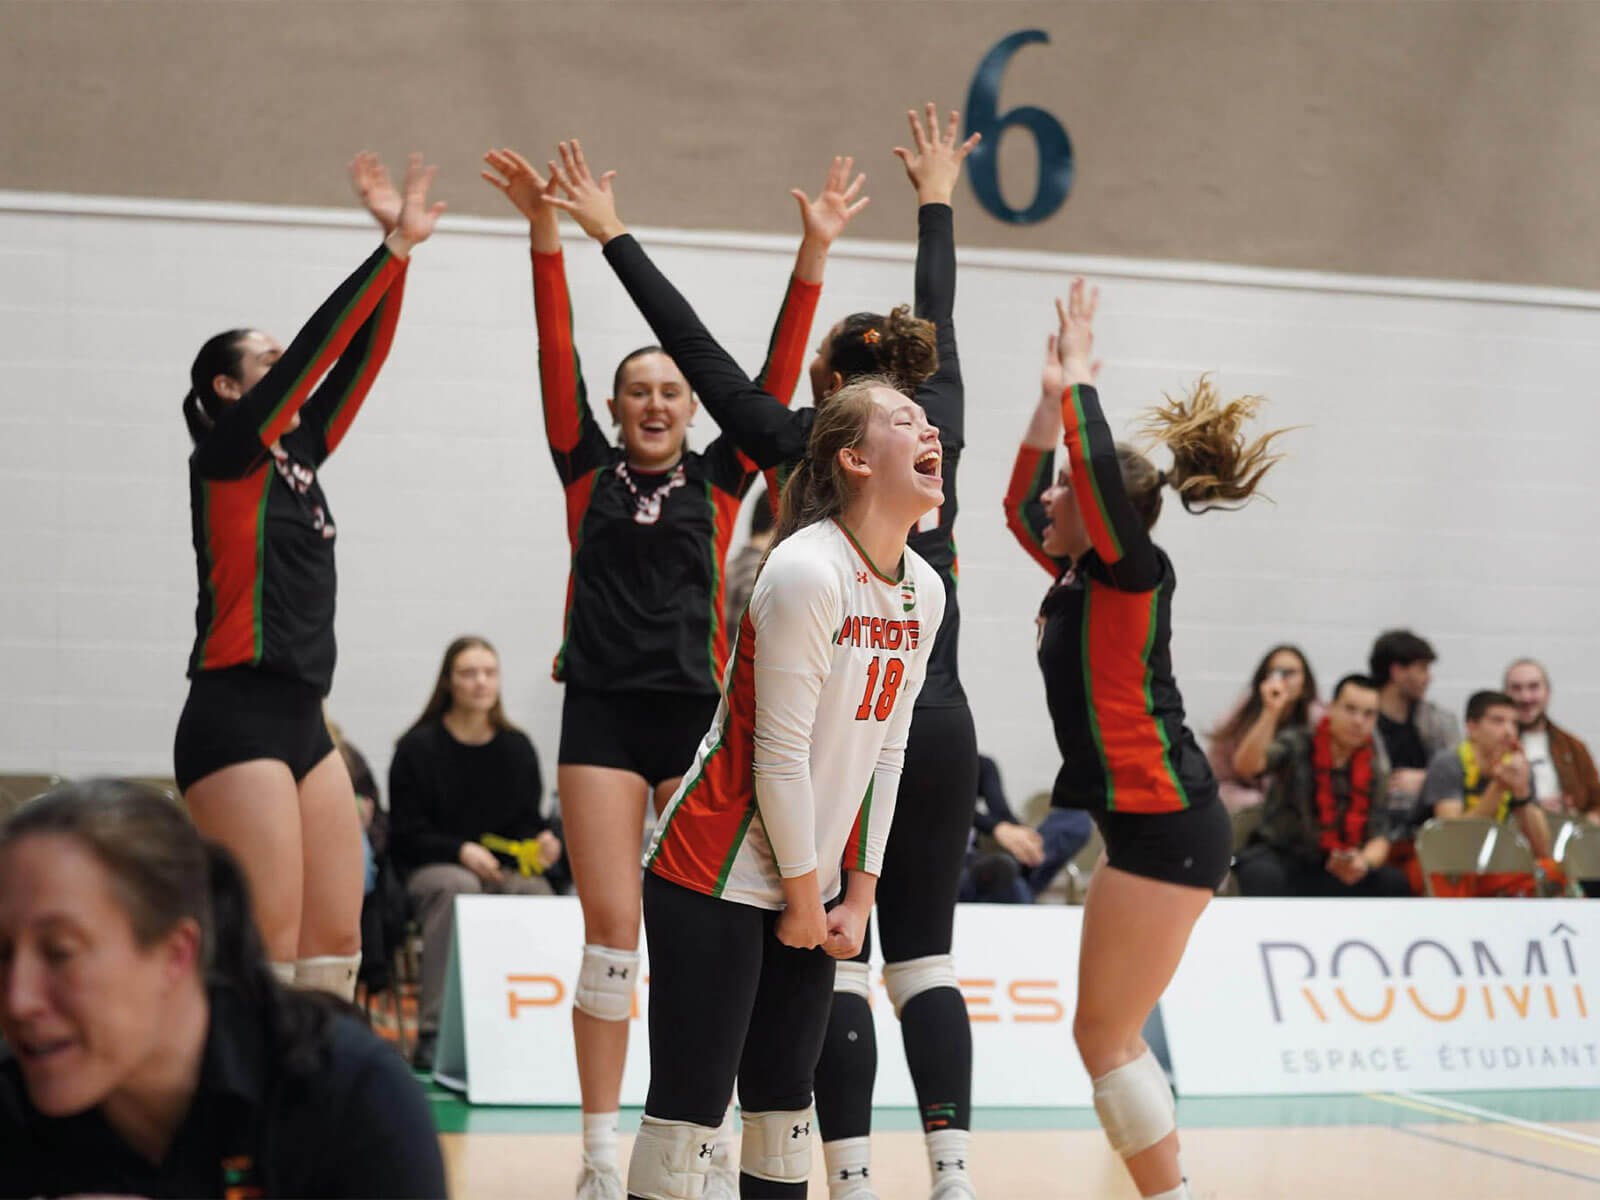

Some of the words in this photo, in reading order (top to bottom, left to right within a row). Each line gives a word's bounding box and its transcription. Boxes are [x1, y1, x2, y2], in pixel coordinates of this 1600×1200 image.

[964, 29, 1075, 226] 6
[855, 656, 904, 721] 18
[1281, 1048, 1410, 1073] ESPACE
